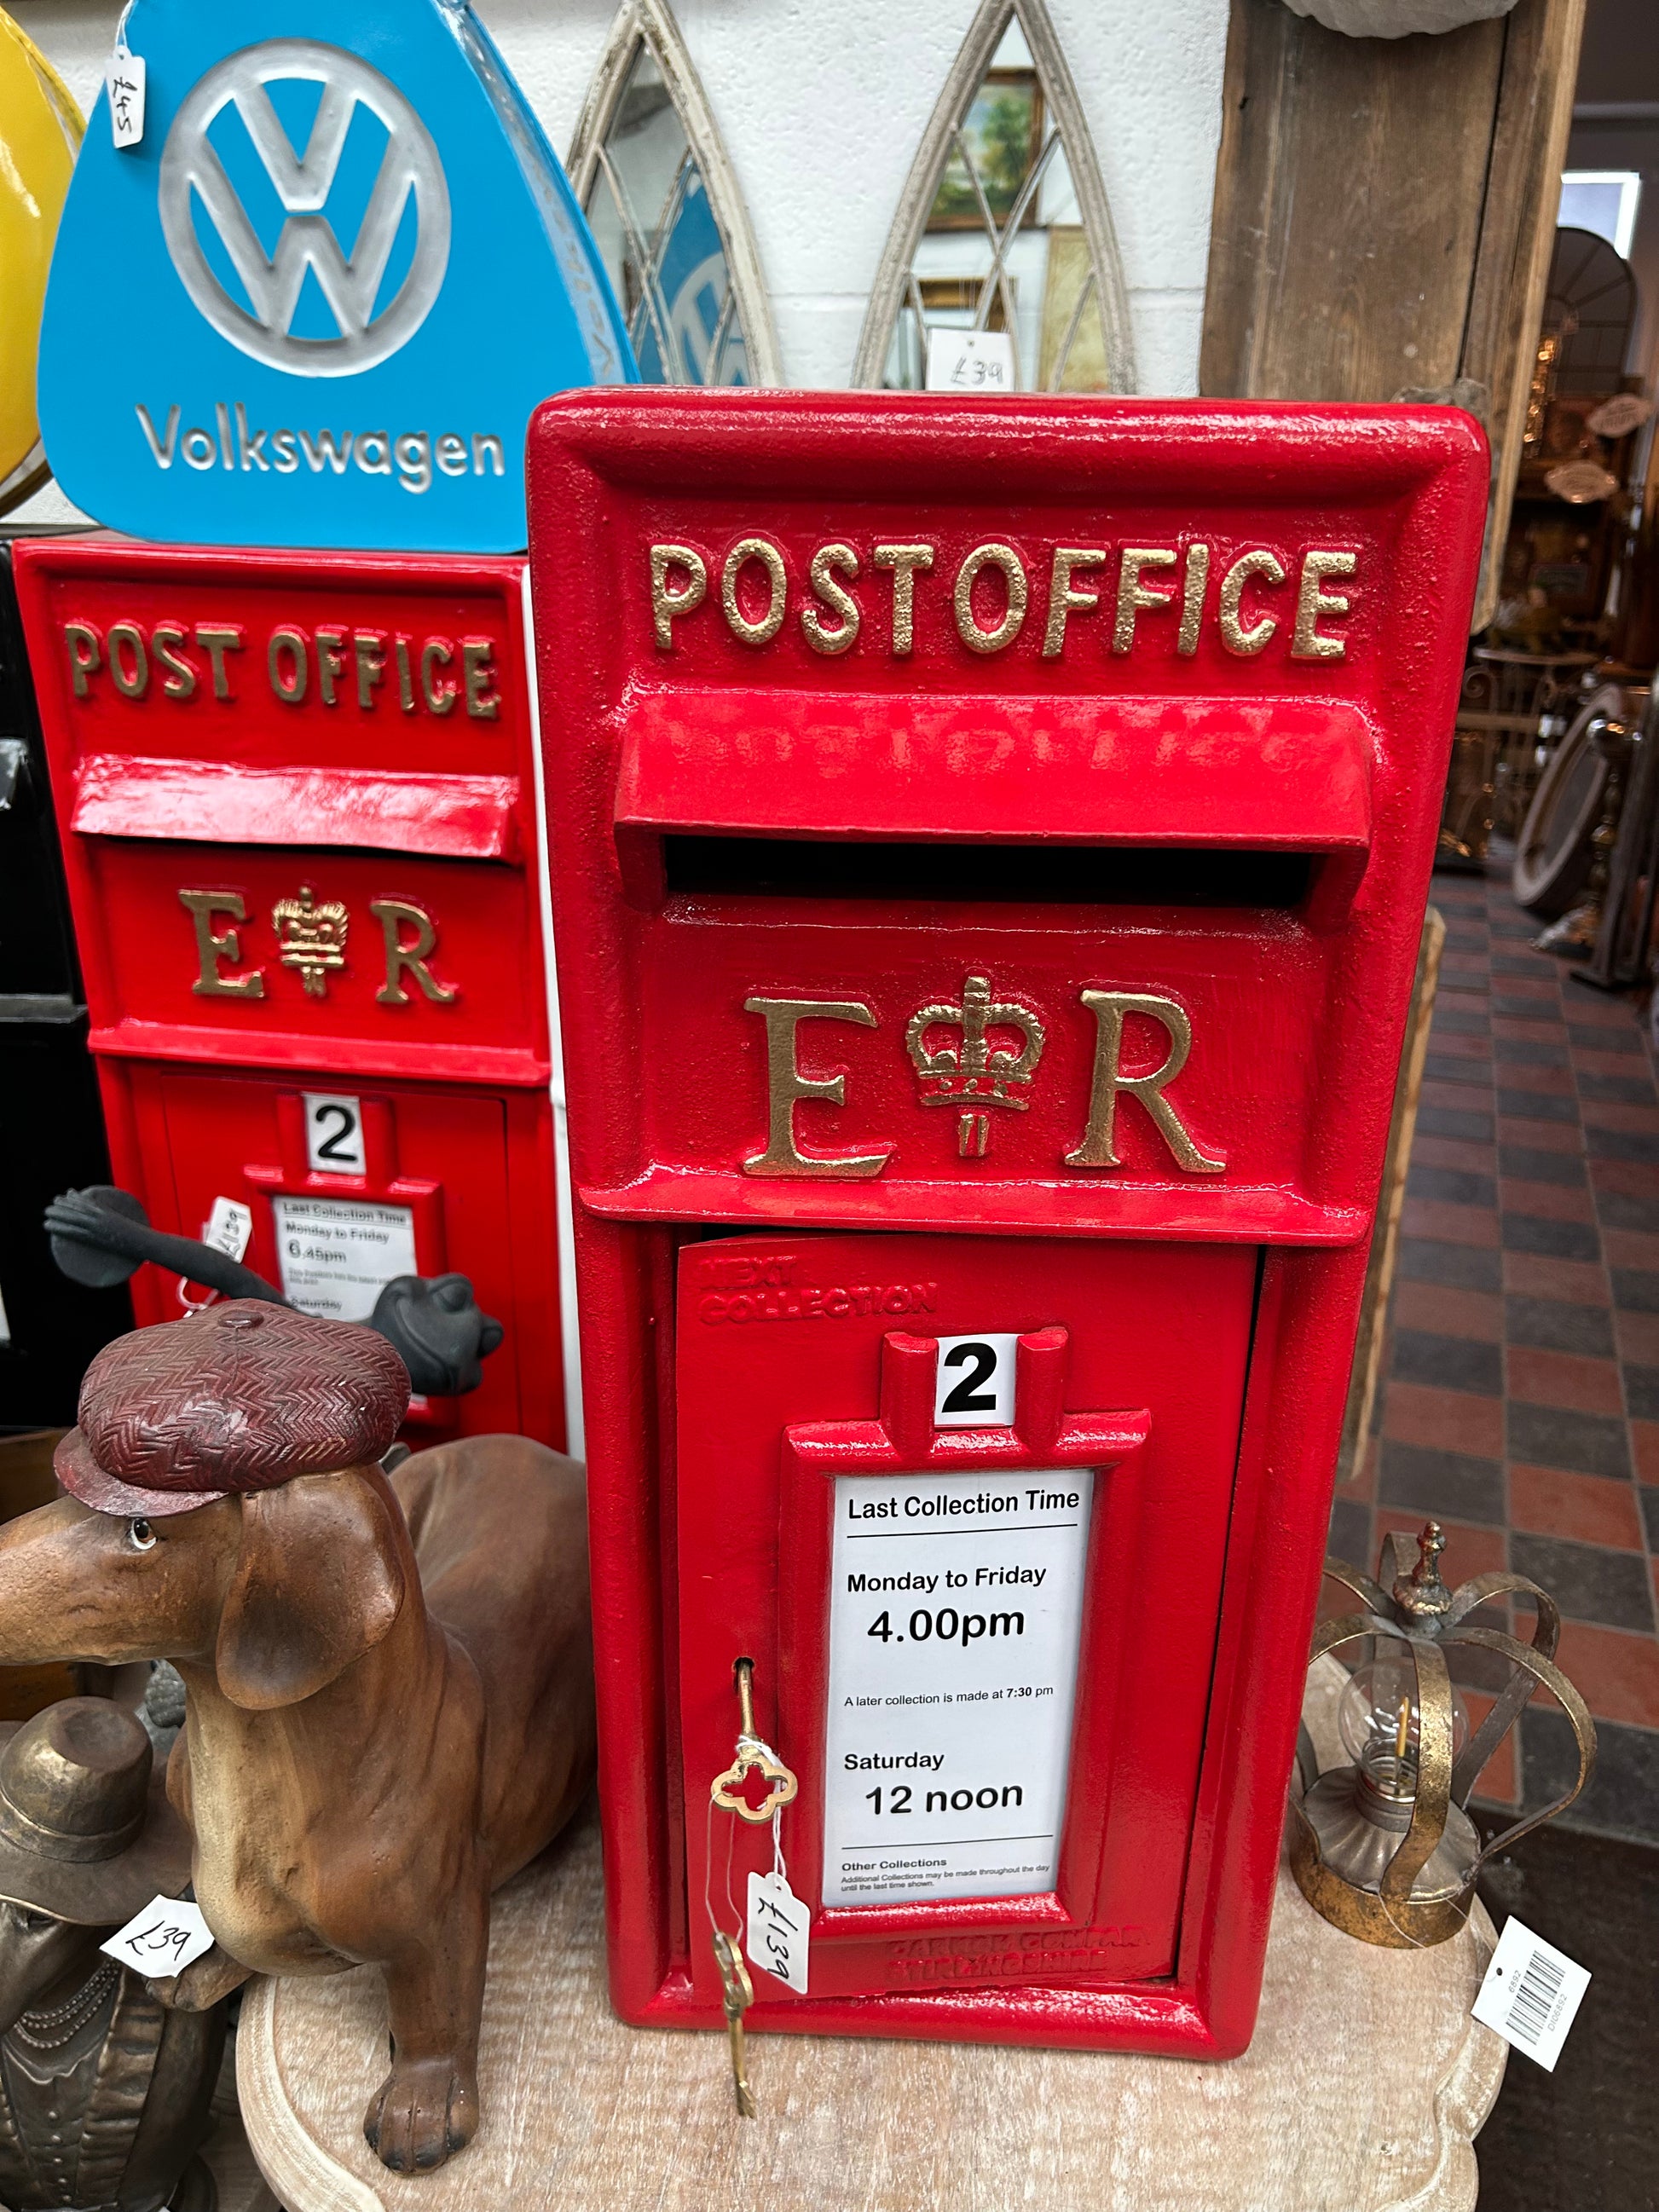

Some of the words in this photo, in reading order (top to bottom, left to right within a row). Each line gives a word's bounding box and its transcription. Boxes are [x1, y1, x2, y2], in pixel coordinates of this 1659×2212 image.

[113, 77, 137, 133] £45
[951, 356, 1003, 386] £39
[135, 401, 506, 494] Volkswagen
[64, 621, 243, 701] POST
[268, 624, 501, 719] OFFICE
[314, 1105, 359, 1164] 2
[284, 1202, 309, 1216] Last
[313, 1204, 374, 1222] Collection
[378, 1210, 406, 1225] Time
[286, 1221, 331, 1239] Monday
[334, 1227, 347, 1239] to
[350, 1229, 390, 1245] Friday
[288, 1239, 347, 1265] 6.45pm
[290, 1295, 342, 1311] Saturday
[699, 1282, 937, 1325] COLLECTION
[940, 1342, 997, 1414] 2
[848, 1498, 898, 1519] Last
[905, 1493, 1018, 1517] Collection
[1026, 1489, 1080, 1511] Time
[847, 1572, 939, 1594] Monday
[945, 1570, 968, 1588] to
[975, 1566, 1046, 1587] Friday
[867, 1608, 1025, 1647] 4.00pm
[844, 1696, 853, 1707] A
[856, 1695, 882, 1706] later
[885, 1694, 939, 1706] collection
[943, 1692, 953, 1703] is
[957, 1690, 989, 1702] made
[991, 1689, 1003, 1699] at
[1006, 1686, 1032, 1699] 7:30
[1035, 1686, 1054, 1698] pm
[844, 1752, 945, 1771] Saturday
[865, 1786, 912, 1815] 12
[926, 1785, 1023, 1813] noon
[841, 1863, 876, 1872] Other
[880, 1858, 947, 1869] Collections
[841, 1874, 879, 1884] Additional
[882, 1872, 923, 1881] Collections
[926, 1872, 941, 1880] may
[944, 1869, 954, 1878] be
[956, 1868, 978, 1877] made
[980, 1867, 1020, 1877] throughout
[1022, 1865, 1033, 1874] the
[1036, 1863, 1050, 1874] day
[841, 1883, 858, 1891] until
[859, 1882, 871, 1891] the
[873, 1881, 887, 1890] last
[889, 1880, 905, 1889] time
[907, 1880, 934, 1889] shown.
[125, 1920, 192, 1961] £39
[758, 1897, 799, 1979] £139
[1507, 1969, 1522, 1994] 6892
